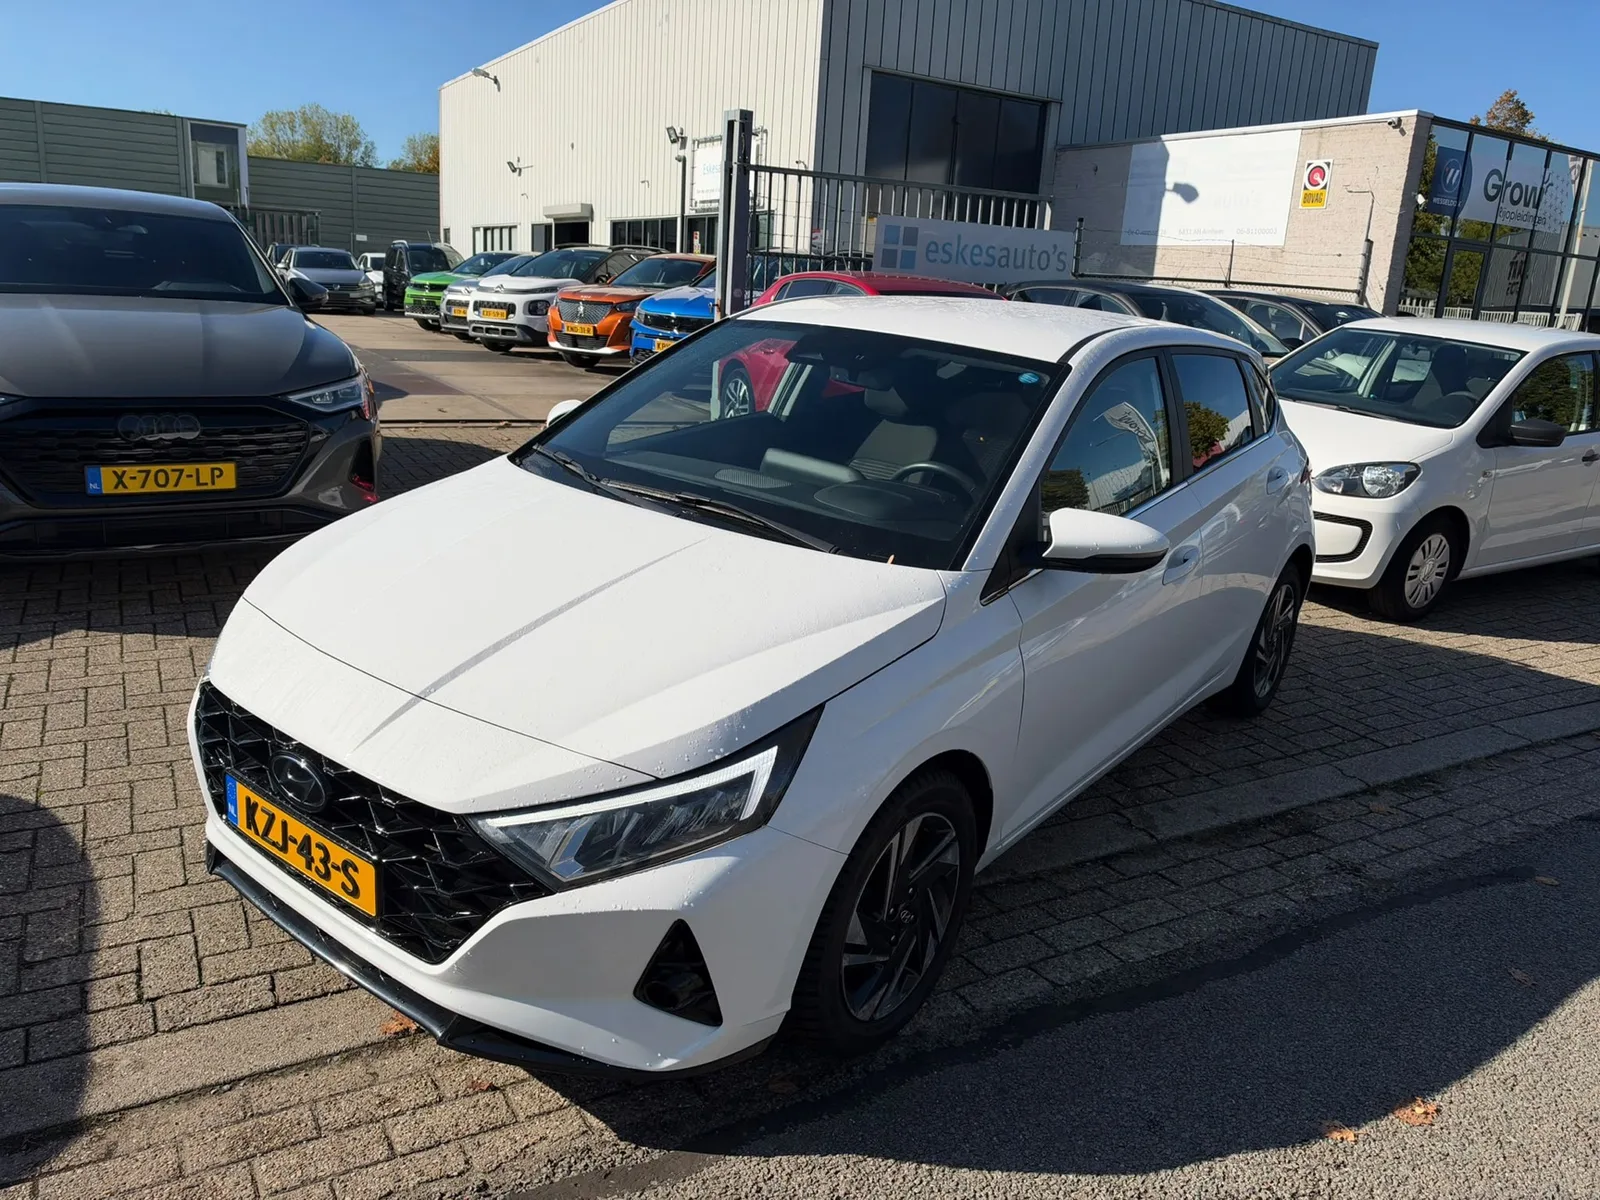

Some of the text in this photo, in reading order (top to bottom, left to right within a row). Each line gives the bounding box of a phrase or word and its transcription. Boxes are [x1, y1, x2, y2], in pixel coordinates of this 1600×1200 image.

[1303, 192, 1324, 204] BOVAG
[1483, 168, 1546, 210] Grow
[925, 234, 1067, 273] eskesauto's
[112, 467, 224, 490] X-707-LP
[244, 795, 361, 900] KZJ-43-S
